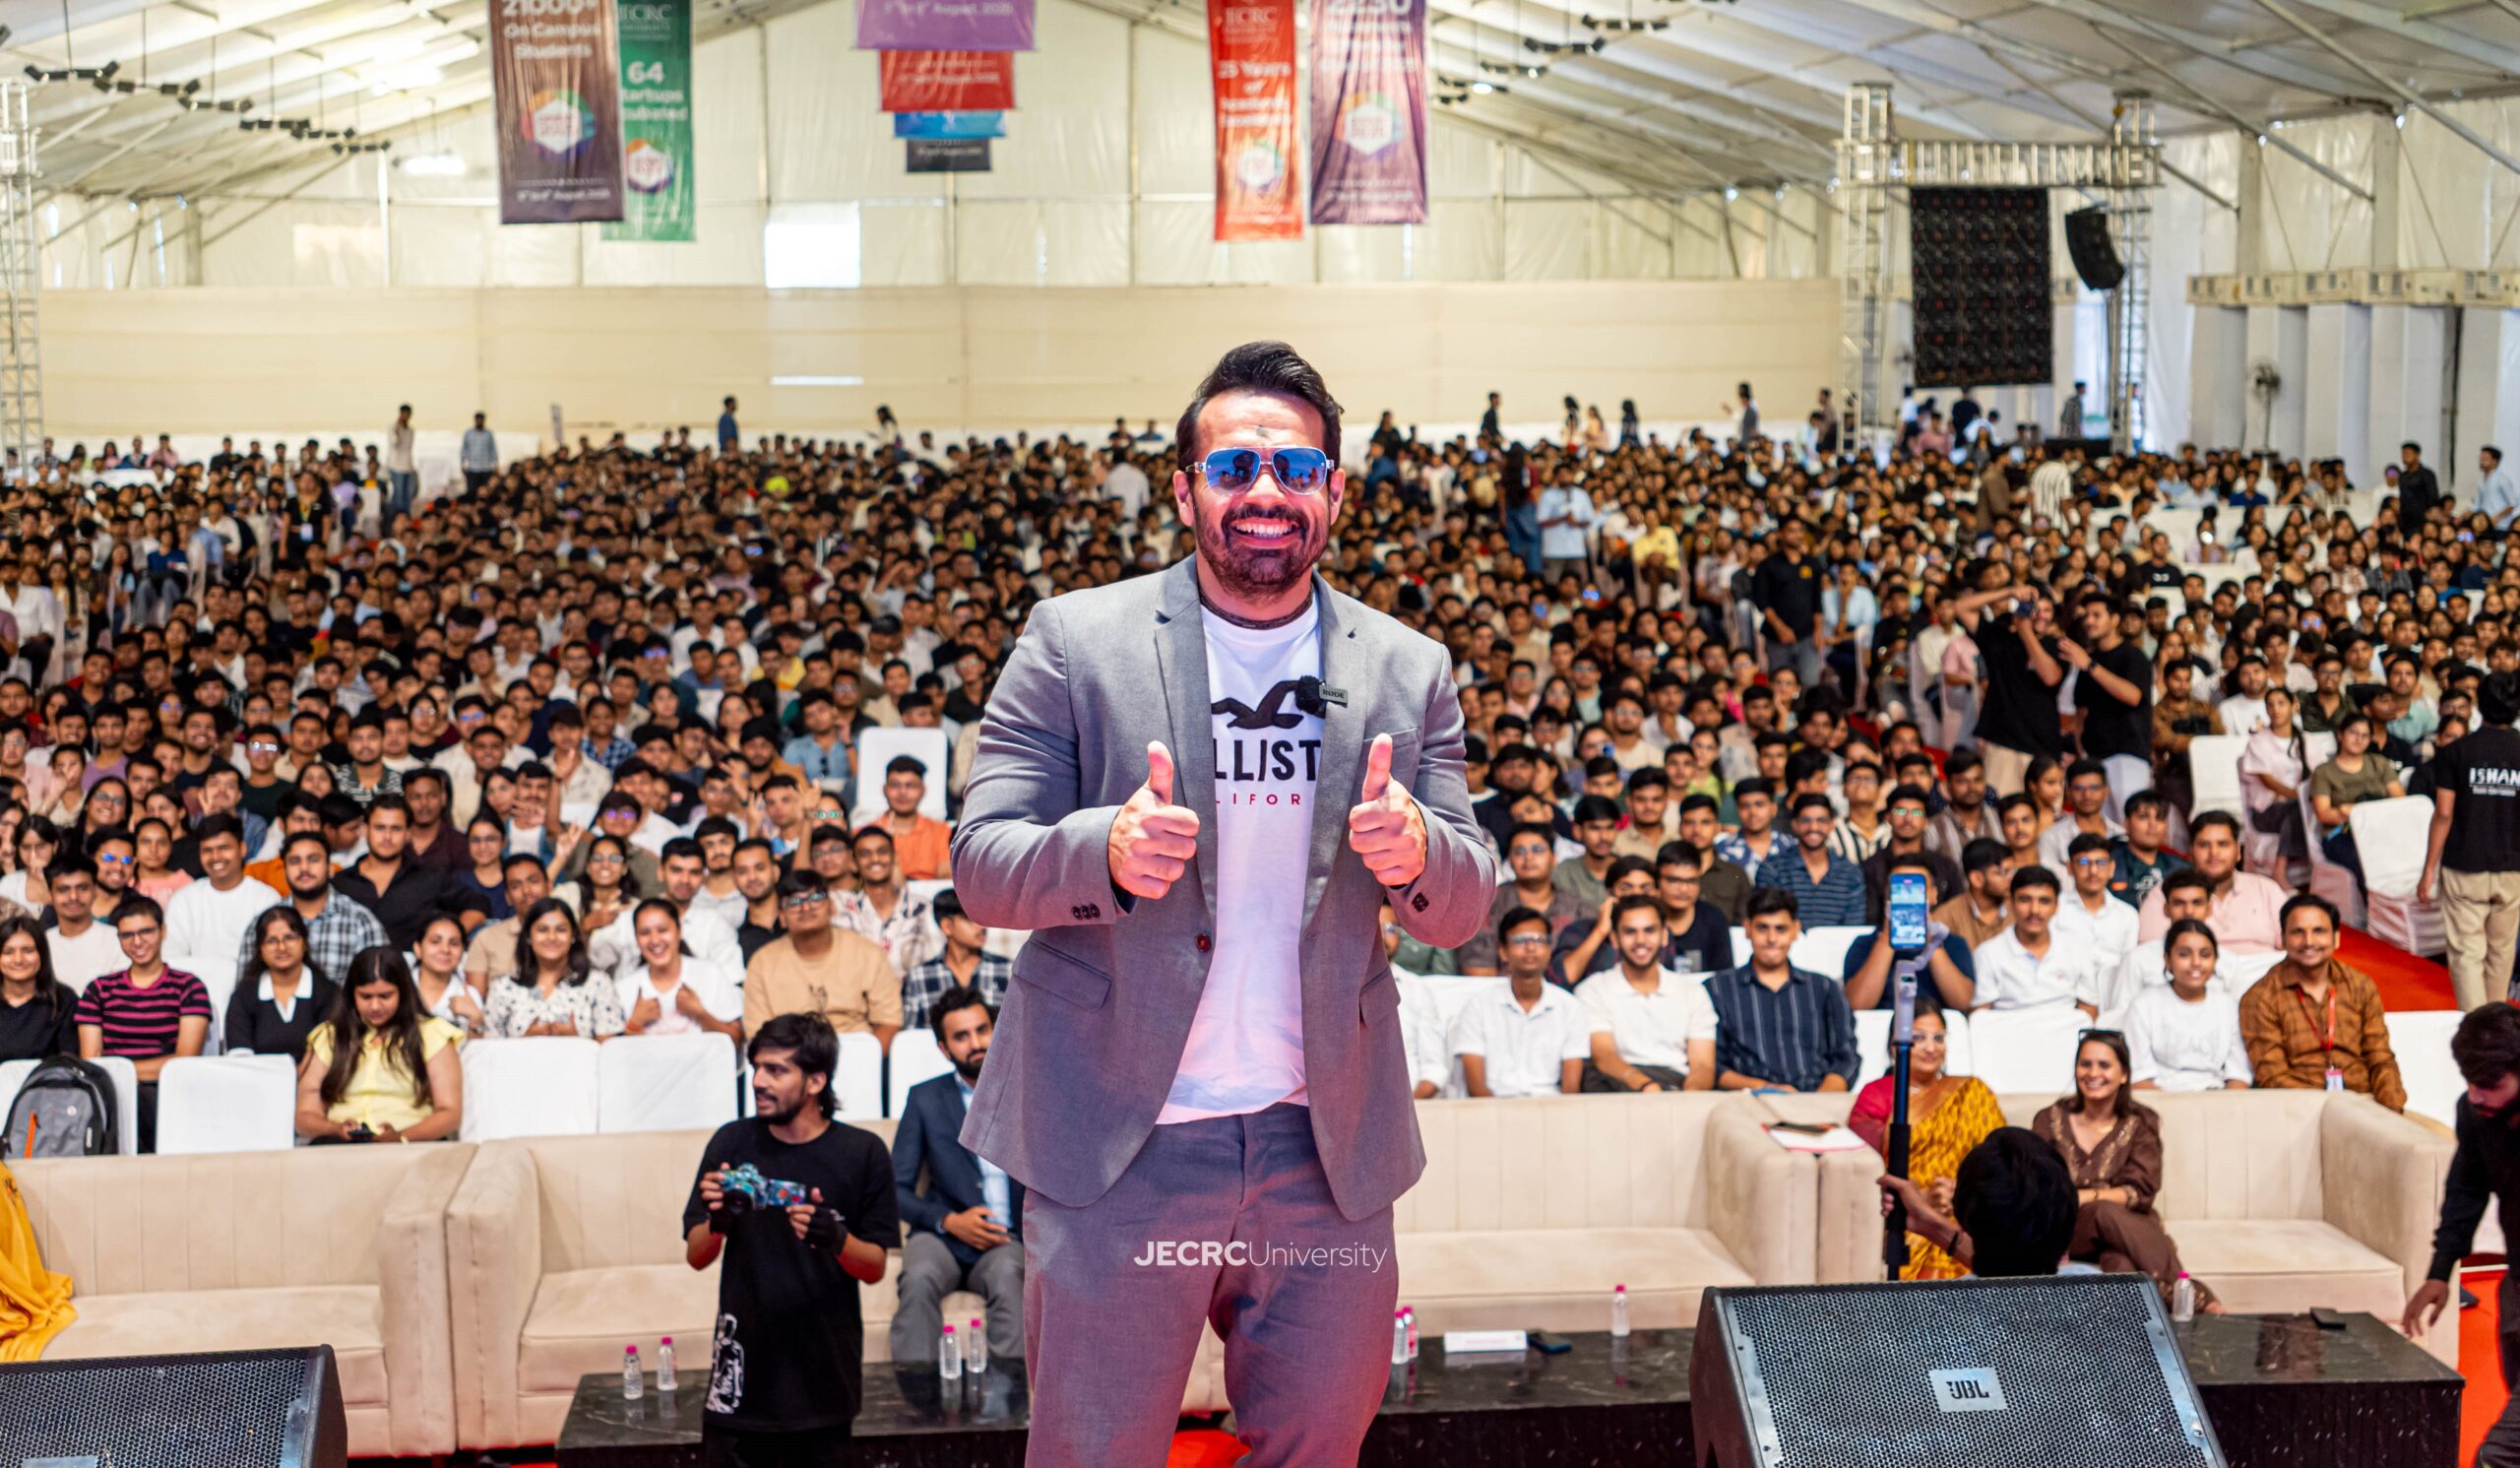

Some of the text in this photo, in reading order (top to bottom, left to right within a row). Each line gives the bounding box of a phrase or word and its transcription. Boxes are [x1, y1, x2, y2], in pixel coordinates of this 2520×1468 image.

[504, 23, 530, 38] On
[532, 22, 601, 40] Campus
[514, 42, 593, 59] Students
[627, 61, 664, 85] 64
[1946, 1379, 1990, 1400] JBL
